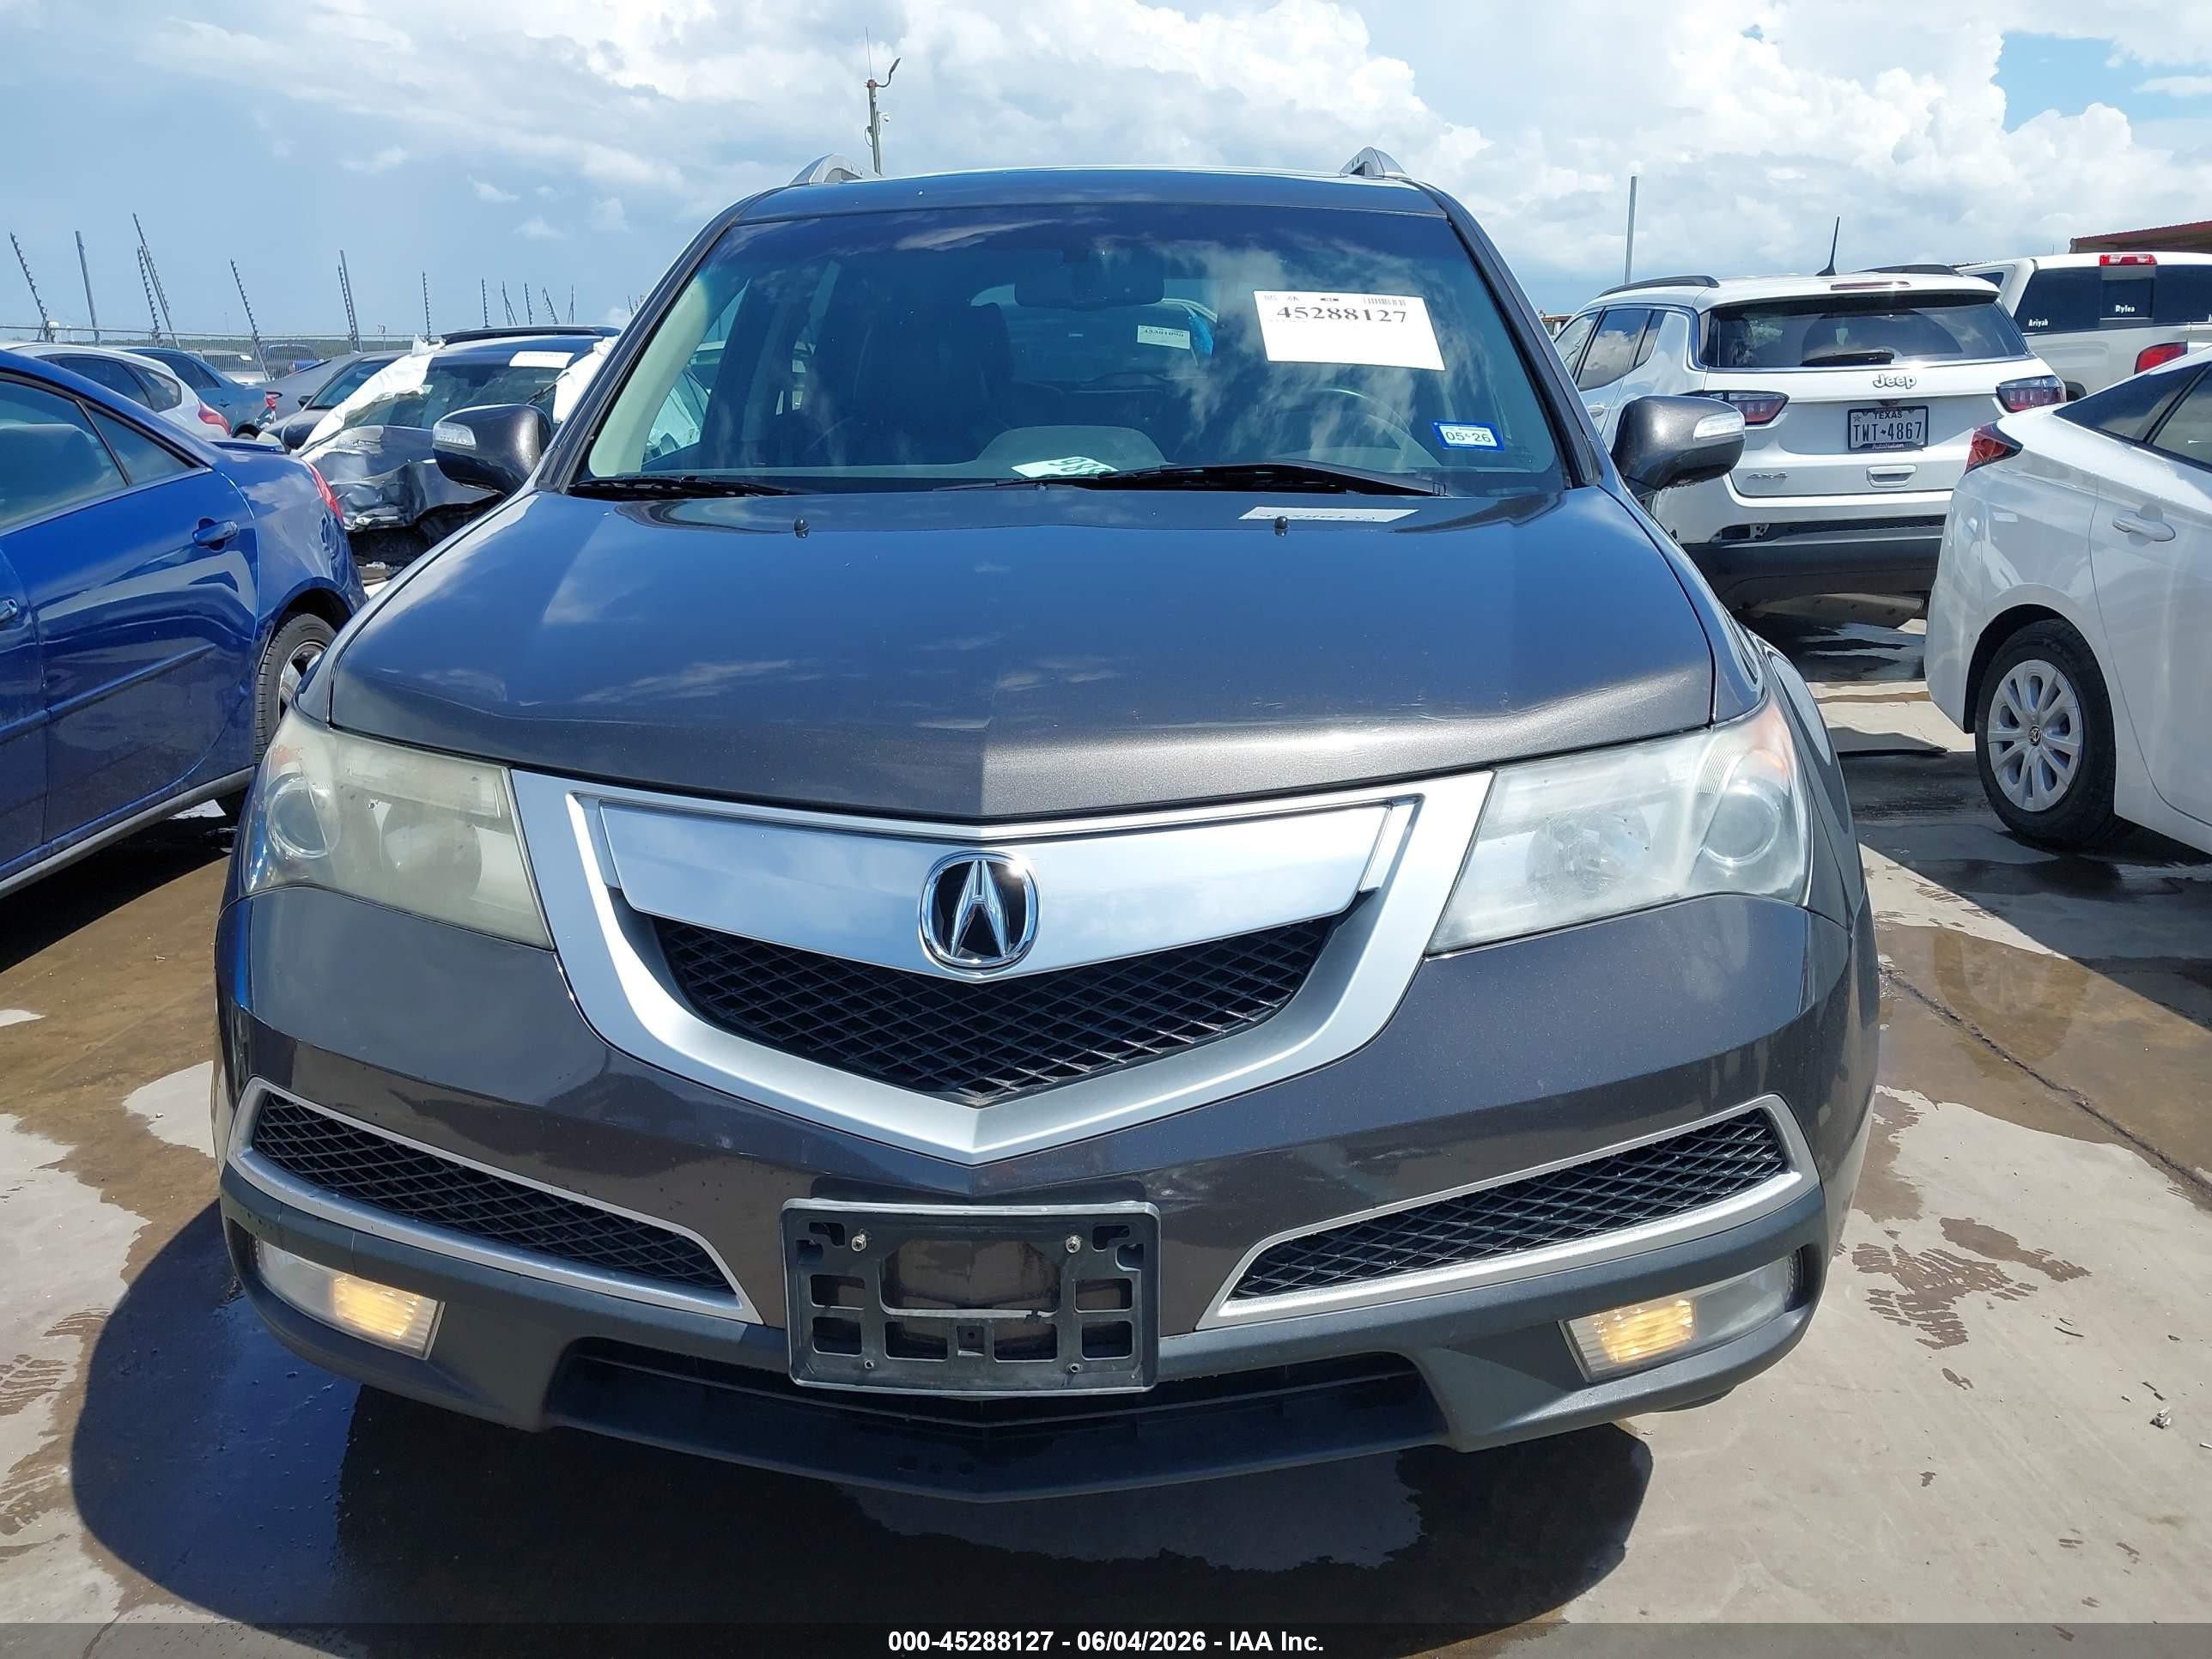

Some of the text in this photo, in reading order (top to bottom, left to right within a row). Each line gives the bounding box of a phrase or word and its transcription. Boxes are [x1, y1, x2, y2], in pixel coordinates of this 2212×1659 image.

[1277, 307, 1407, 323] 45288127
[1873, 374, 1917, 390] Jeep
[1873, 411, 1904, 420] TEXAS
[1887, 422, 1923, 441] 4867
